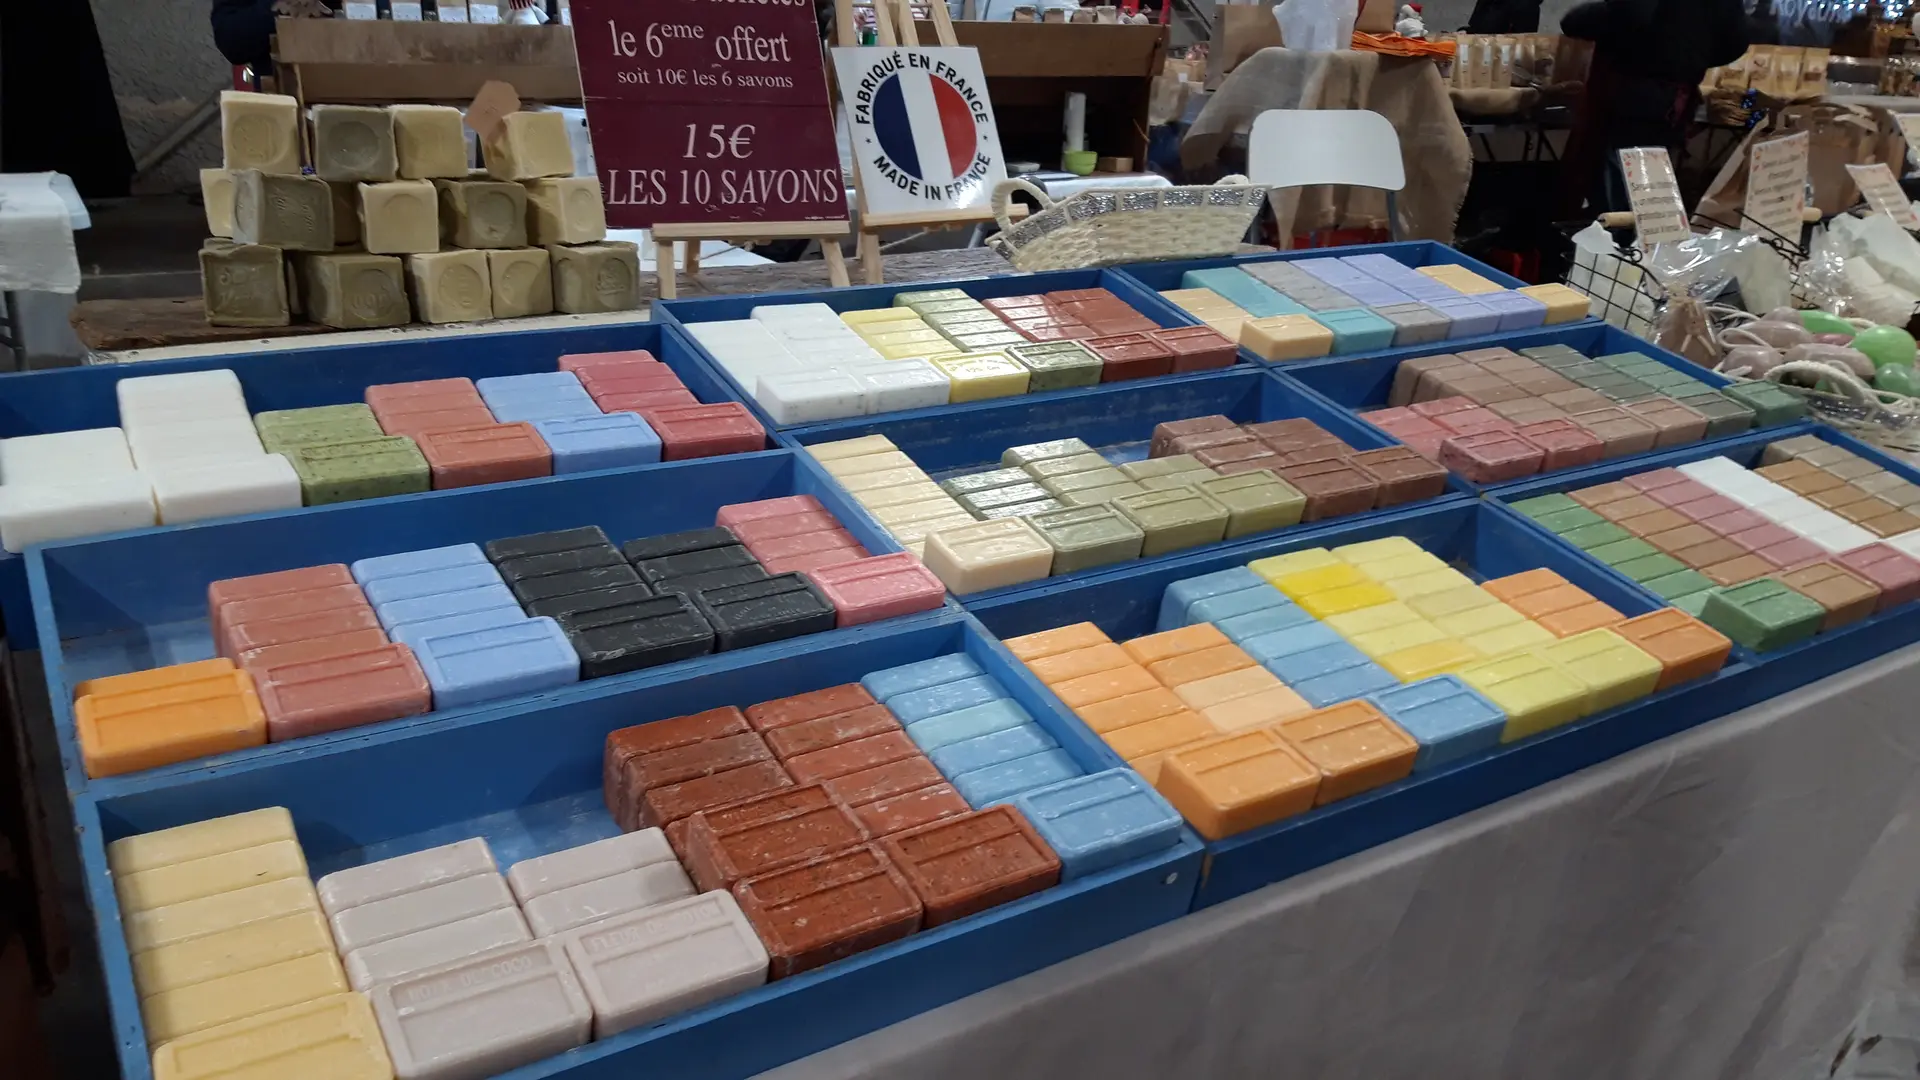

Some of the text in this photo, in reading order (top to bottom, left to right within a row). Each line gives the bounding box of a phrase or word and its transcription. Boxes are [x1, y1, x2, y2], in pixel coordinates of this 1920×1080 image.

[608, 19, 791, 62] le 6eme offert
[617, 68, 793, 88] soit 10€ les 6 savons
[856, 51, 989, 124] FABRIQUÉ EN FRANCE
[683, 123, 756, 159] 15€
[607, 168, 838, 205] LES 10 SAVONS
[873, 152, 991, 200] MADE IN FRANCE
